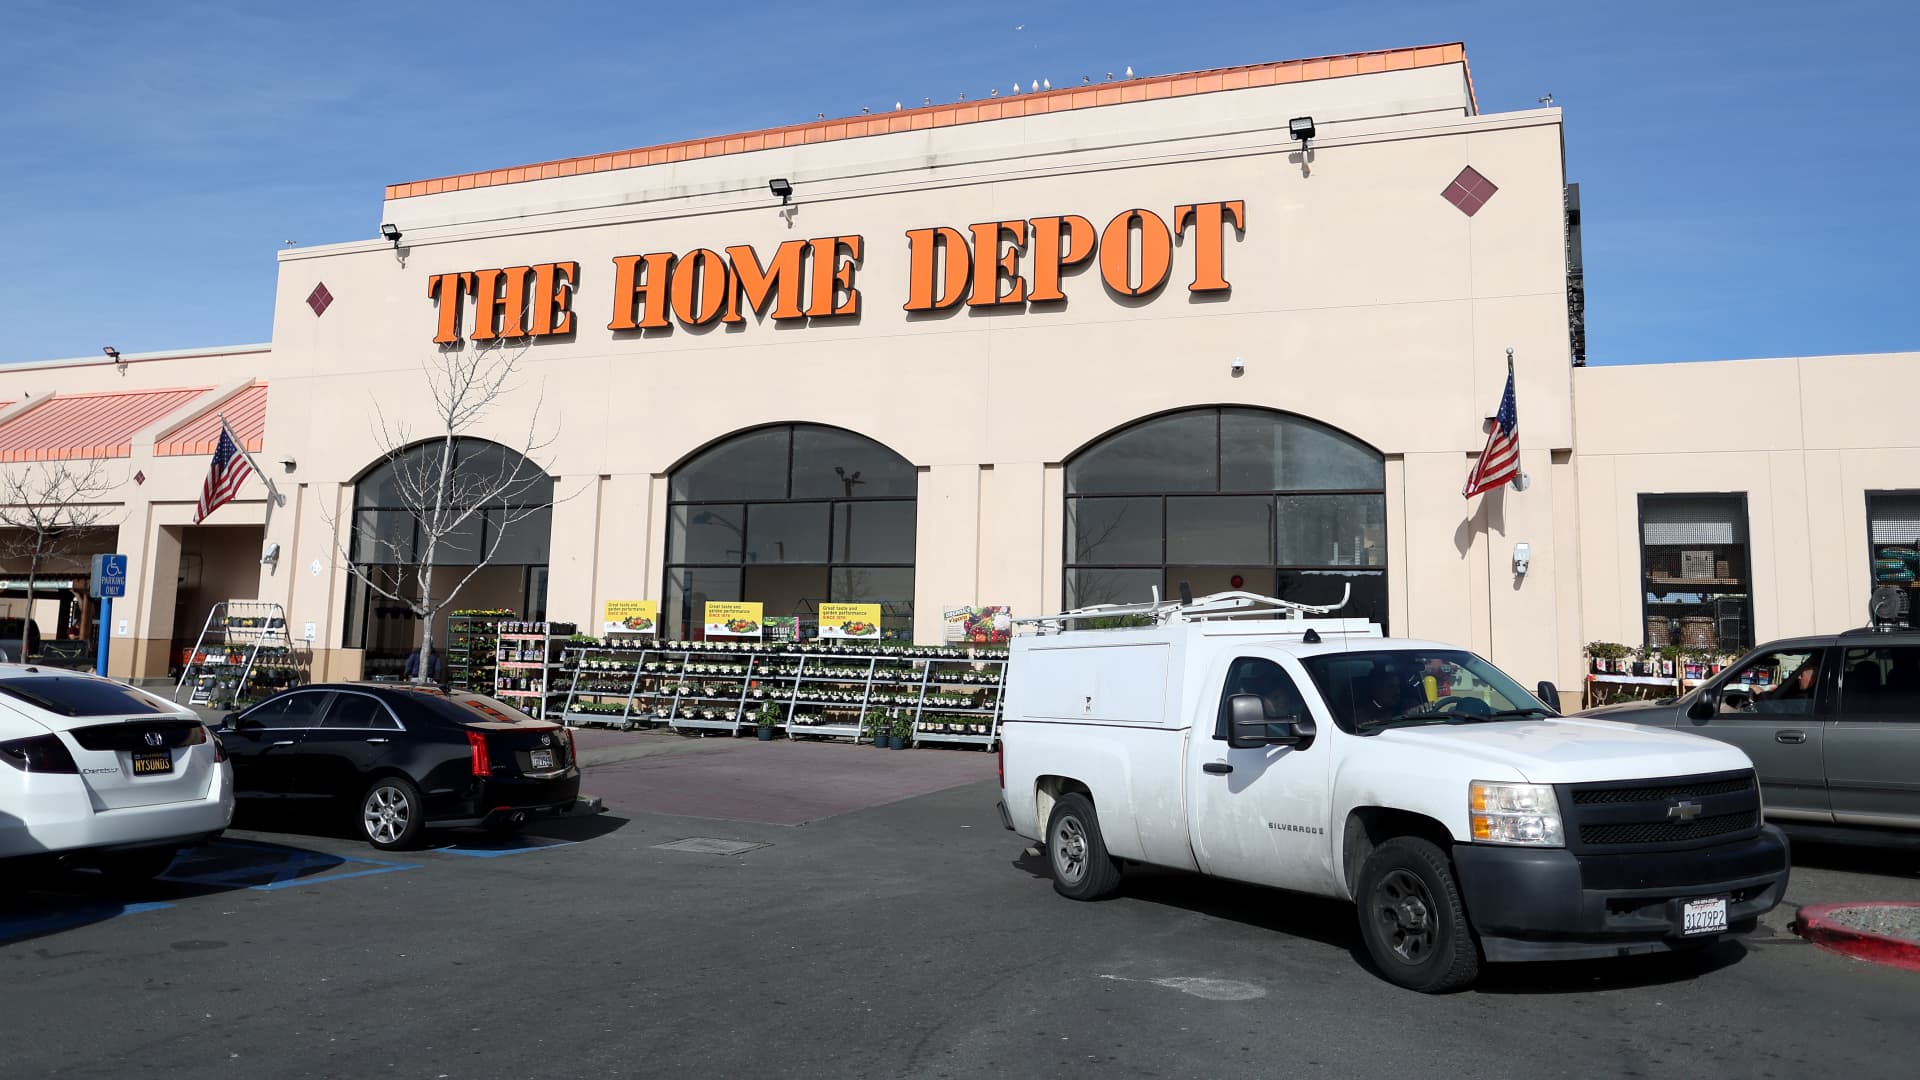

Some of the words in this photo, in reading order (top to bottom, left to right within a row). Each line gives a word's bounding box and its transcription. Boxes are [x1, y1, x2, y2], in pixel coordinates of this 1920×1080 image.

[428, 261, 575, 343] THE
[607, 235, 861, 329] HOME
[903, 200, 1244, 311] DEPOT
[1268, 822, 1317, 834] SILVERADO
[1686, 910, 1725, 929] 31279P2
